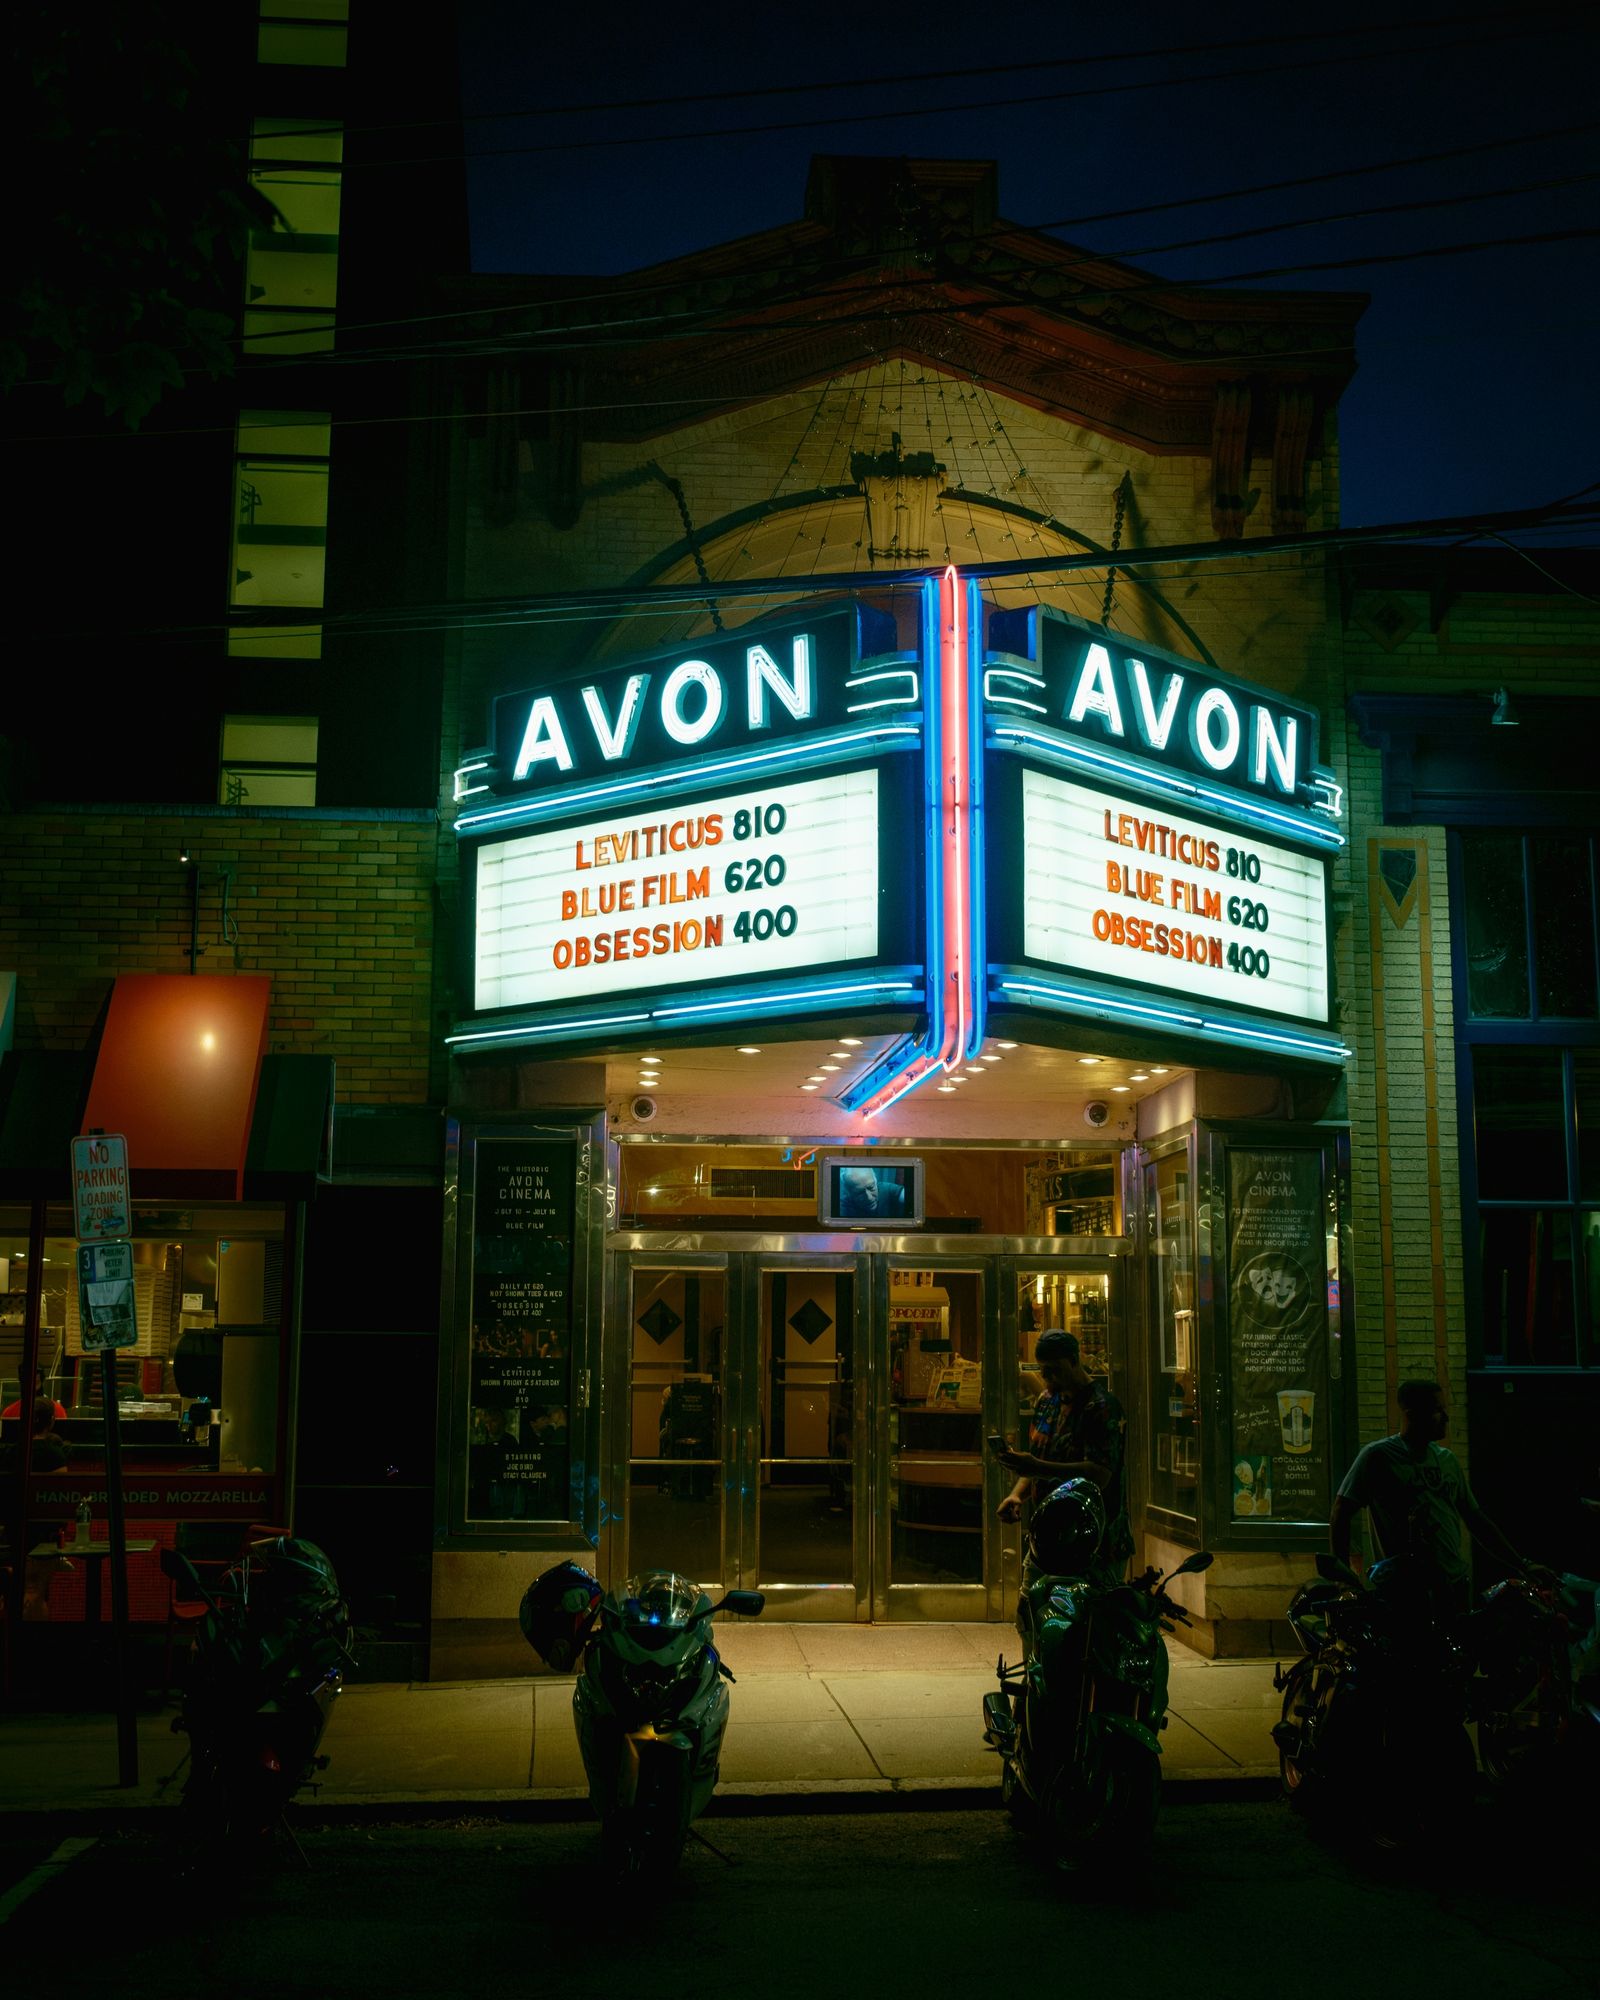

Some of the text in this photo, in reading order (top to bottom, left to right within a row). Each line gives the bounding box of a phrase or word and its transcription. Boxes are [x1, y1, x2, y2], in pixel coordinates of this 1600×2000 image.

[512, 633, 816, 782] AVON
[1065, 642, 1298, 794] AVON
[575, 802, 787, 871] LEVITICUS 810
[1104, 809, 1261, 883] LEVITICUS 810
[561, 854, 787, 921] BLUE FILM 620
[1106, 860, 1269, 932] BLUE FILM 620
[552, 904, 799, 971] OBSESSION 400
[1092, 909, 1270, 979] OBSESSION 400
[89, 1145, 109, 1164] NO
[77, 1167, 125, 1188] PARKING
[516, 1165, 549, 1173] HISTORIC
[1255, 1170, 1291, 1182] AVON
[508, 1175, 544, 1187] AVON
[81, 1190, 123, 1207] LOADING
[499, 1188, 551, 1200] CINEMA
[1249, 1185, 1297, 1197] CINEMA
[83, 1250, 91, 1270] 3
[500, 1282, 520, 1290] DAILY
[497, 1302, 544, 1310] OBSESSION
[888, 1308, 940, 1319] OPCORN
[36, 1490, 267, 1504] HAND BRADED MOZZARELLA
